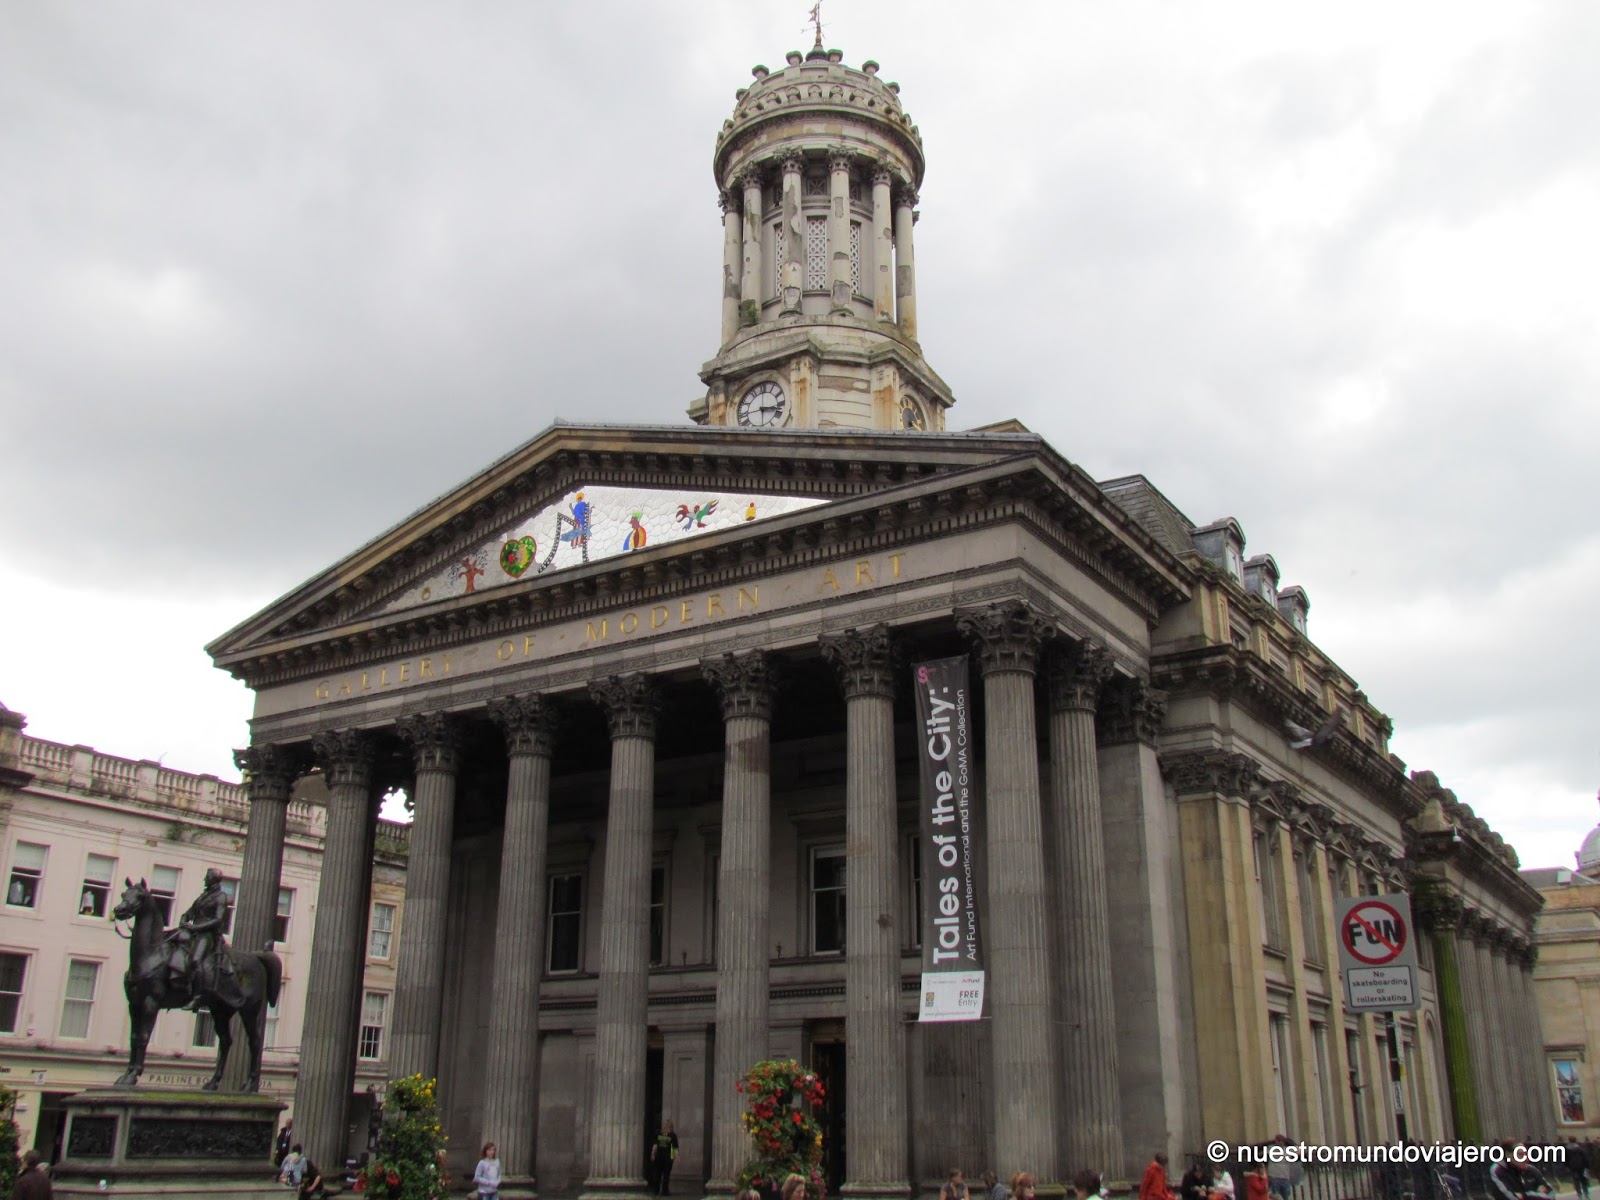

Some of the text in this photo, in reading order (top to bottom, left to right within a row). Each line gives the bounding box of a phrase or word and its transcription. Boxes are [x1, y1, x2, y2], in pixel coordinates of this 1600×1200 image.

[316, 552, 908, 700] GALLERY OF MODERN ART
[926, 686, 955, 761] City:
[931, 770, 955, 825] the
[956, 689, 976, 961] Art Fund International and the GoMA Collection
[932, 834, 958, 867] of
[932, 876, 960, 964] Tales
[1348, 920, 1402, 947] FUN
[959, 990, 979, 998] FREE
[1352, 979, 1408, 987] skateboarding
[958, 999, 978, 1007] Entry
[1357, 995, 1407, 1003] rollerskating
[149, 1074, 192, 1085] PAULINE
